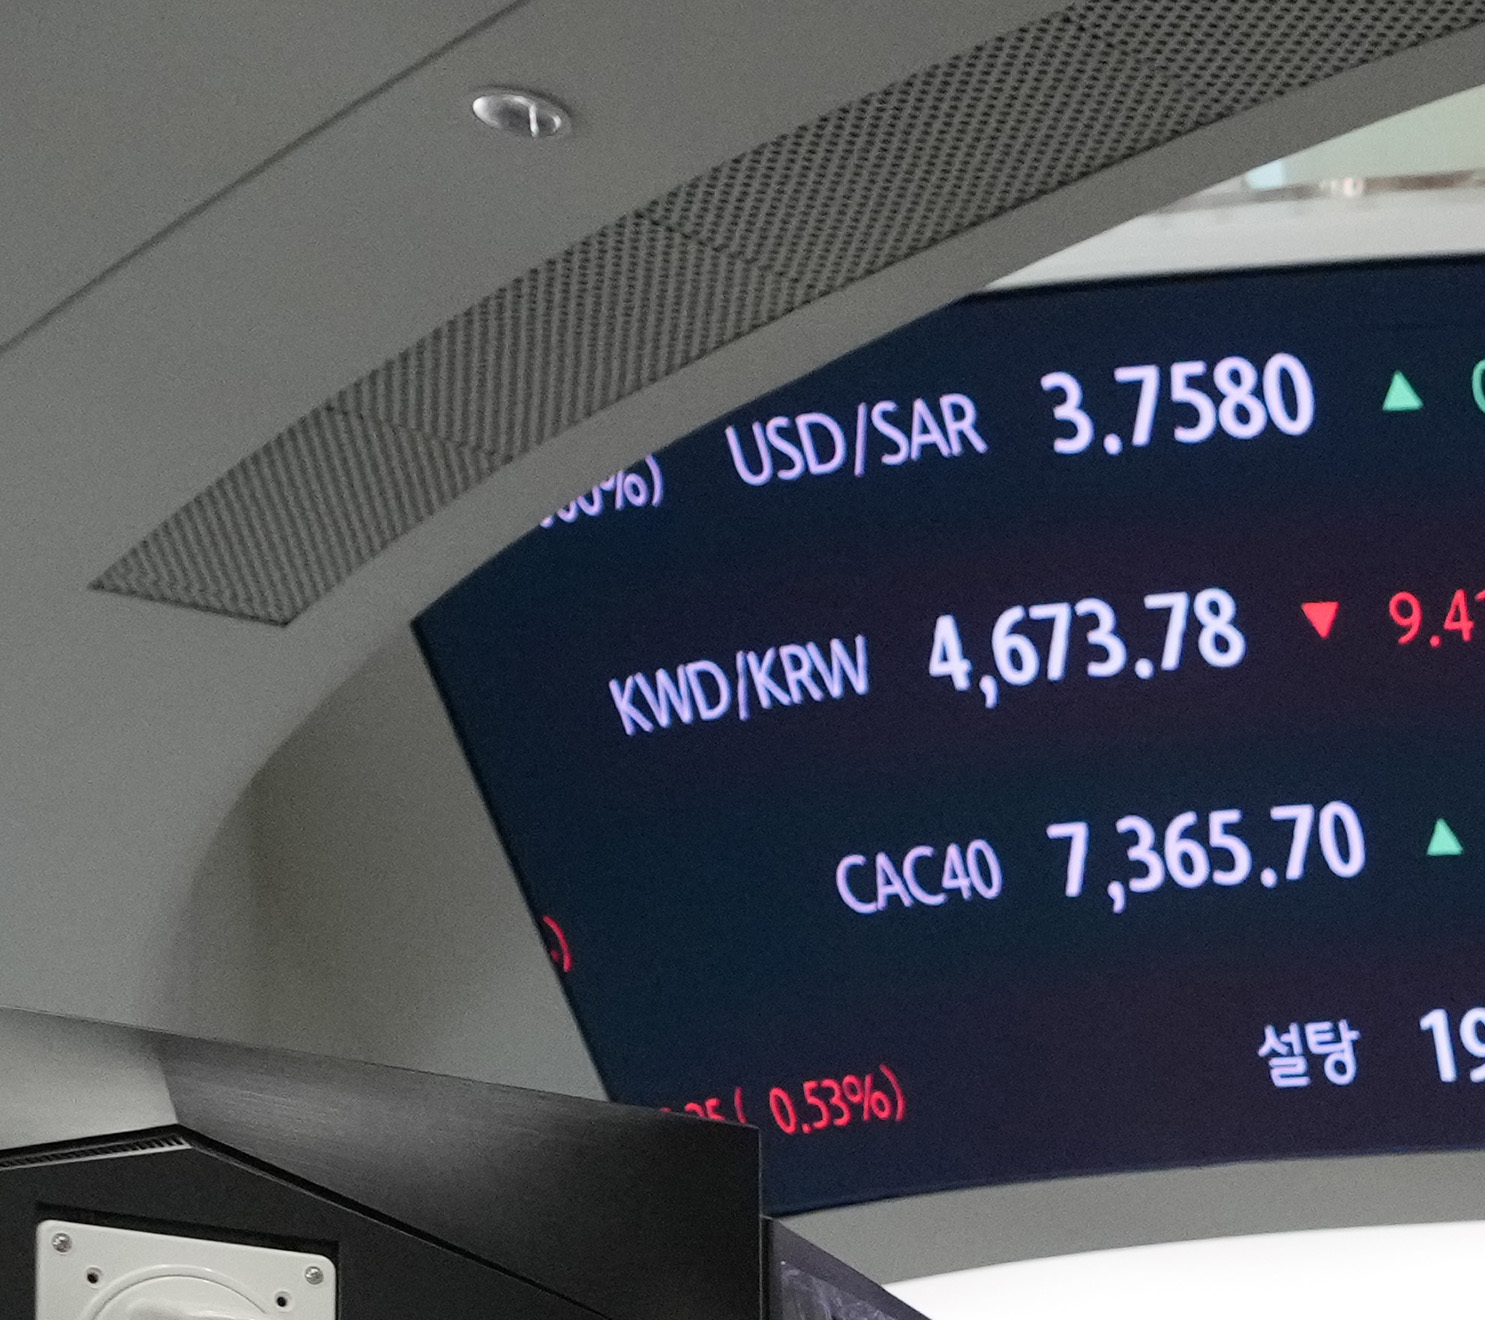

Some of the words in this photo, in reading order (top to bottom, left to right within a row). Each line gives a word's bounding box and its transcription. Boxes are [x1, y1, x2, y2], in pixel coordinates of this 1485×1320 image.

[725, 393, 988, 486] USD/SAR
[1040, 352, 1316, 456] 3.7580
[608, 634, 869, 736] KWD/KRW
[928, 587, 1247, 709] 4,673.78
[835, 838, 1003, 915] CAC40
[1046, 800, 1366, 914] 7,365.70
[769, 1066, 905, 1135] 0.53%)
[1257, 1019, 1361, 1088] 설탕
